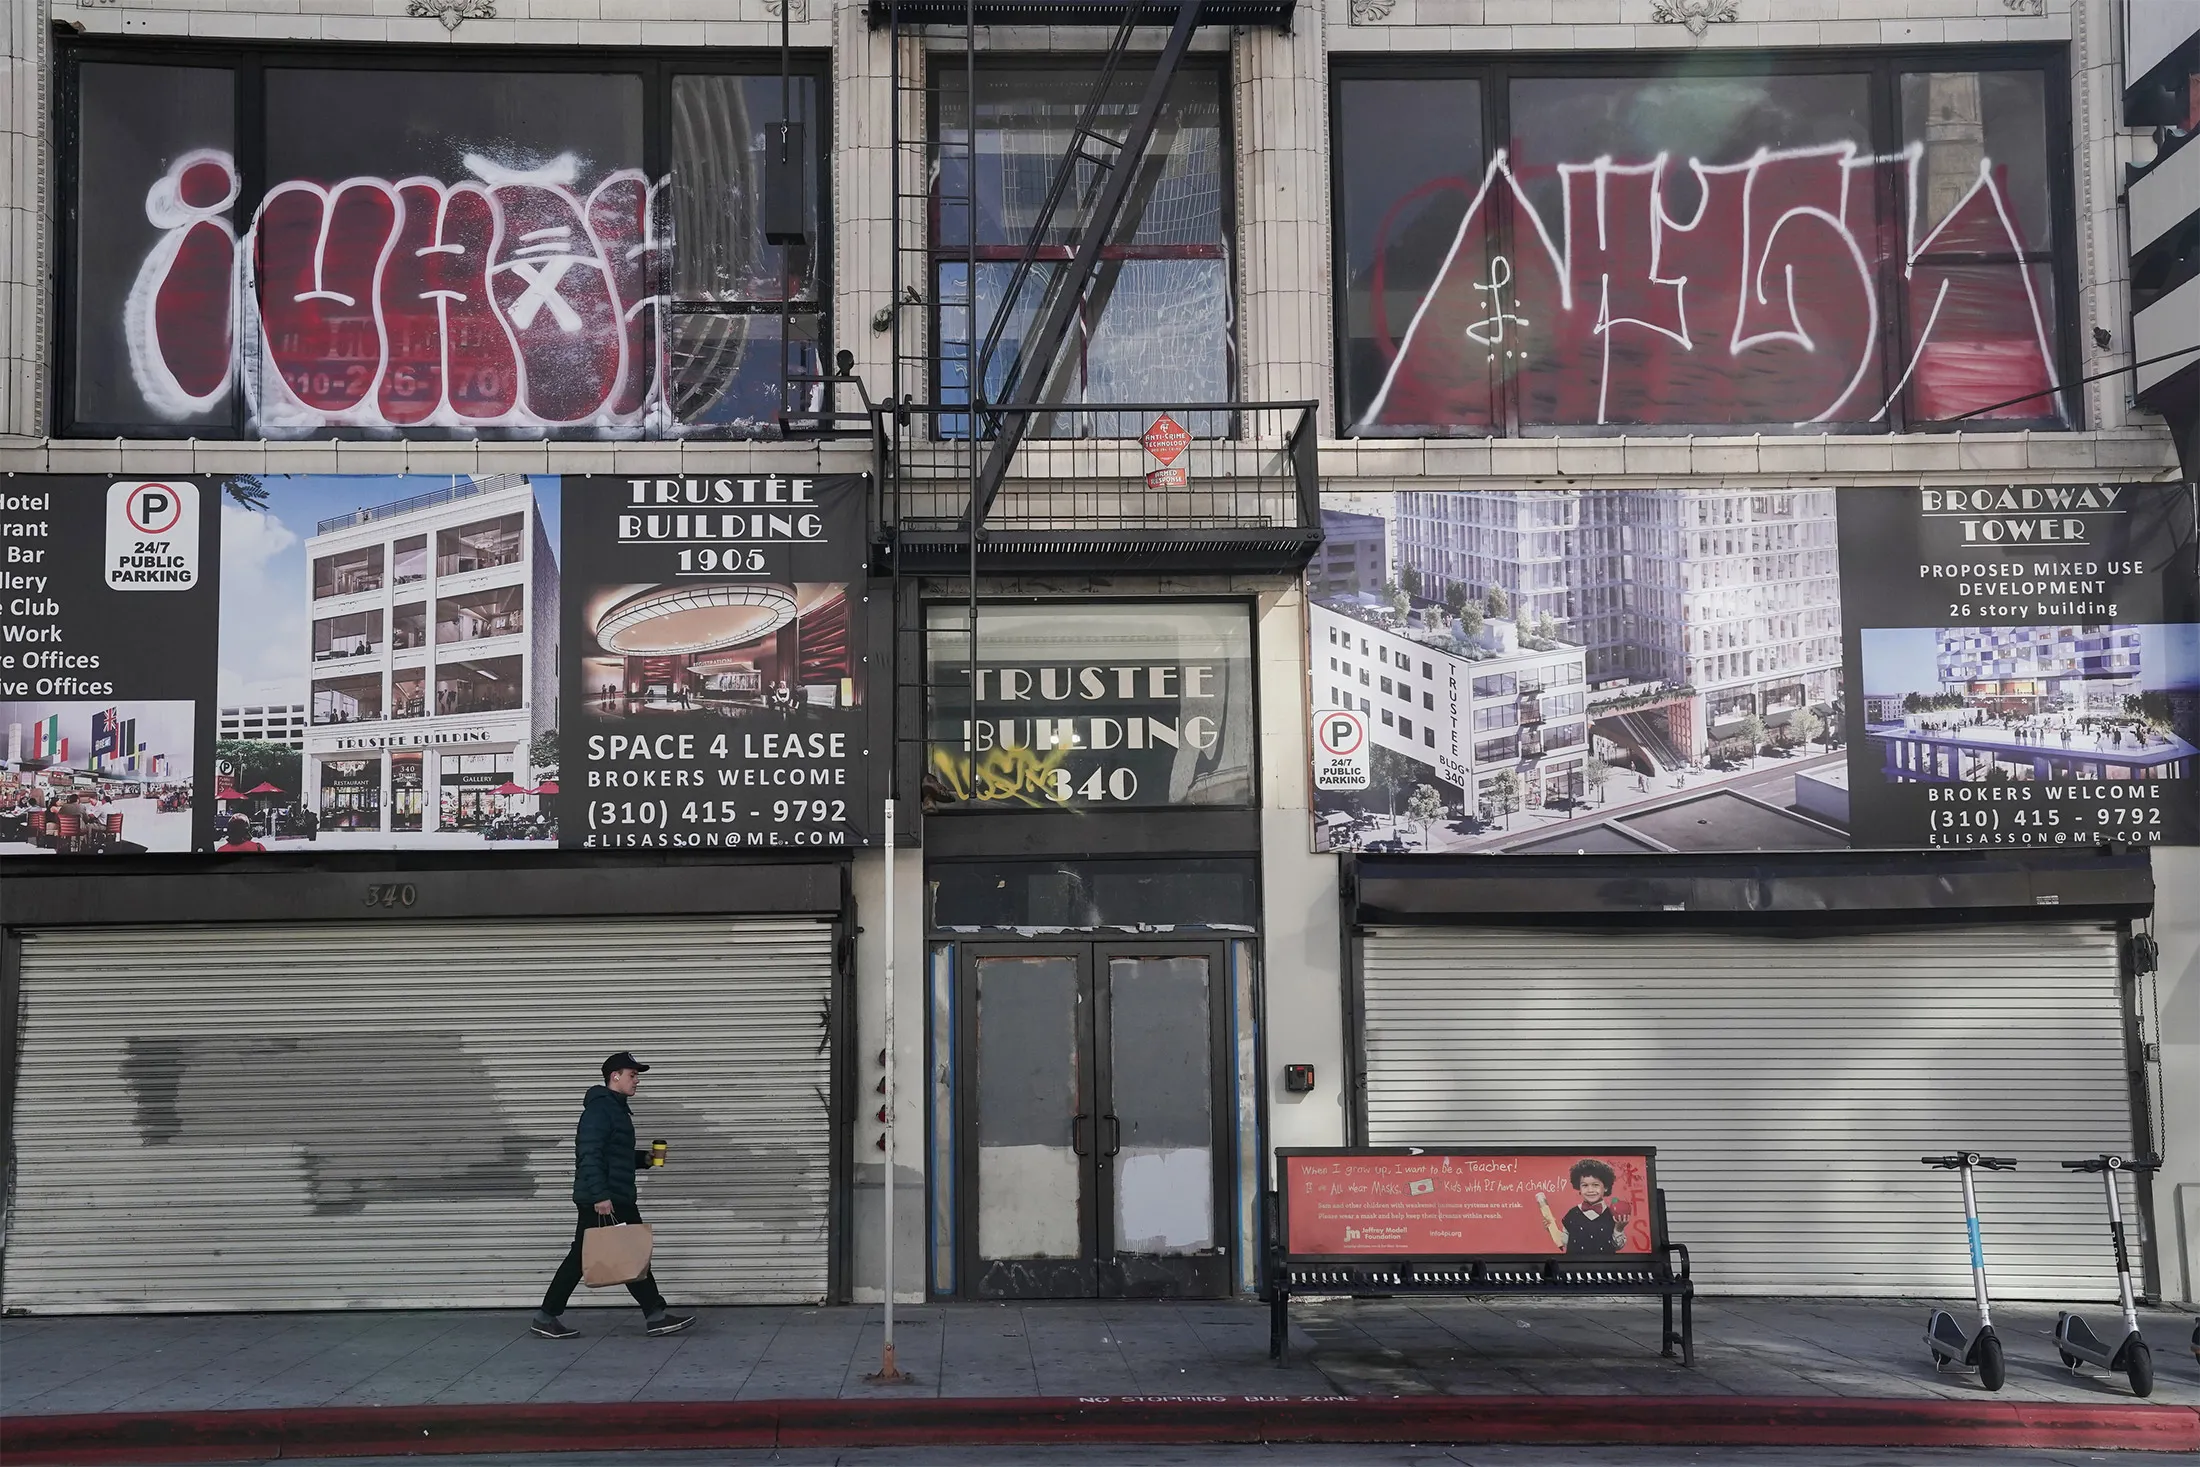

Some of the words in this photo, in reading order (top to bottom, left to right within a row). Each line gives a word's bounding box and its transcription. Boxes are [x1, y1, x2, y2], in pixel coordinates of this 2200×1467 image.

[1145, 433, 1186, 441] ANTI-CRIME
[1151, 476, 1182, 484] RESPONSE
[1154, 470, 1177, 478] ARMED
[627, 479, 814, 503] TRUSTEE
[1921, 487, 2122, 511] BROADWAY
[0, 521, 49, 537] rant
[618, 514, 823, 539] BUILDING
[1960, 519, 2087, 542] TOWER
[7, 546, 45, 563] Bar
[134, 541, 171, 555] 24/7
[119, 555, 185, 569] PUBLIC
[677, 549, 766, 571] 1905
[111, 570, 192, 583] PARKING
[1920, 564, 2024, 578] PROPOSED
[2034, 562, 2099, 577] MIXED
[2107, 561, 2144, 575] USE
[1959, 580, 2106, 597] DEVELOPMENT
[10, 598, 60, 616] Club
[1950, 603, 1971, 617] 26
[1980, 603, 2029, 619] story
[2038, 602, 2118, 617] building
[2, 624, 63, 642] Work
[0, 655, 15, 669] e
[22, 650, 100, 669] Offices
[0, 678, 29, 696] ve
[35, 677, 113, 696] Offices
[960, 667, 1215, 700] TRUSTEE
[1448, 662, 1459, 757] TRUSTEE
[336, 735, 407, 749] TRUSTEE
[413, 731, 491, 744] BUILDING
[963, 716, 1219, 752] BUILDING
[587, 734, 696, 761] SPACE
[709, 734, 729, 759] 4
[744, 733, 846, 759] LEASE
[400, 765, 415, 773] 340
[1323, 767, 1361, 776] PUBLIC
[1331, 758, 1353, 767] 24/7
[588, 768, 705, 787] BROKERS
[718, 768, 846, 786] WELCOME
[1045, 766, 1138, 802] 340
[1319, 776, 1366, 784] PARKING
[1444, 769, 1465, 787] 340
[1928, 786, 2032, 801] BROKERS
[2046, 785, 2161, 801] WELCOME
[587, 800, 669, 829] (310)
[681, 801, 737, 823] 415
[773, 800, 847, 823] 9792
[1929, 810, 2000, 830] (310)
[2014, 809, 2061, 826] 415
[2097, 808, 2161, 825] 9792
[587, 831, 846, 848] ELISASSON@ME.COM
[1929, 831, 2161, 844] ELISASSON@ME.COM
[365, 884, 416, 907] 340
[1301, 1165, 1327, 1175] When
[1332, 1163, 1341, 1174] I
[1345, 1166, 1371, 1176] grow
[1375, 1166, 1391, 1178] up,
[1395, 1164, 1402, 1174] I
[1405, 1164, 1426, 1173] want
[1430, 1165, 1438, 1174] to
[1442, 1164, 1453, 1174] be
[1465, 1158, 1518, 1173] Teacher!
[1444, 1180, 1461, 1192] Kids
[1465, 1180, 1481, 1192] with
[1430, 1230, 1462, 1238] info4pi.org
